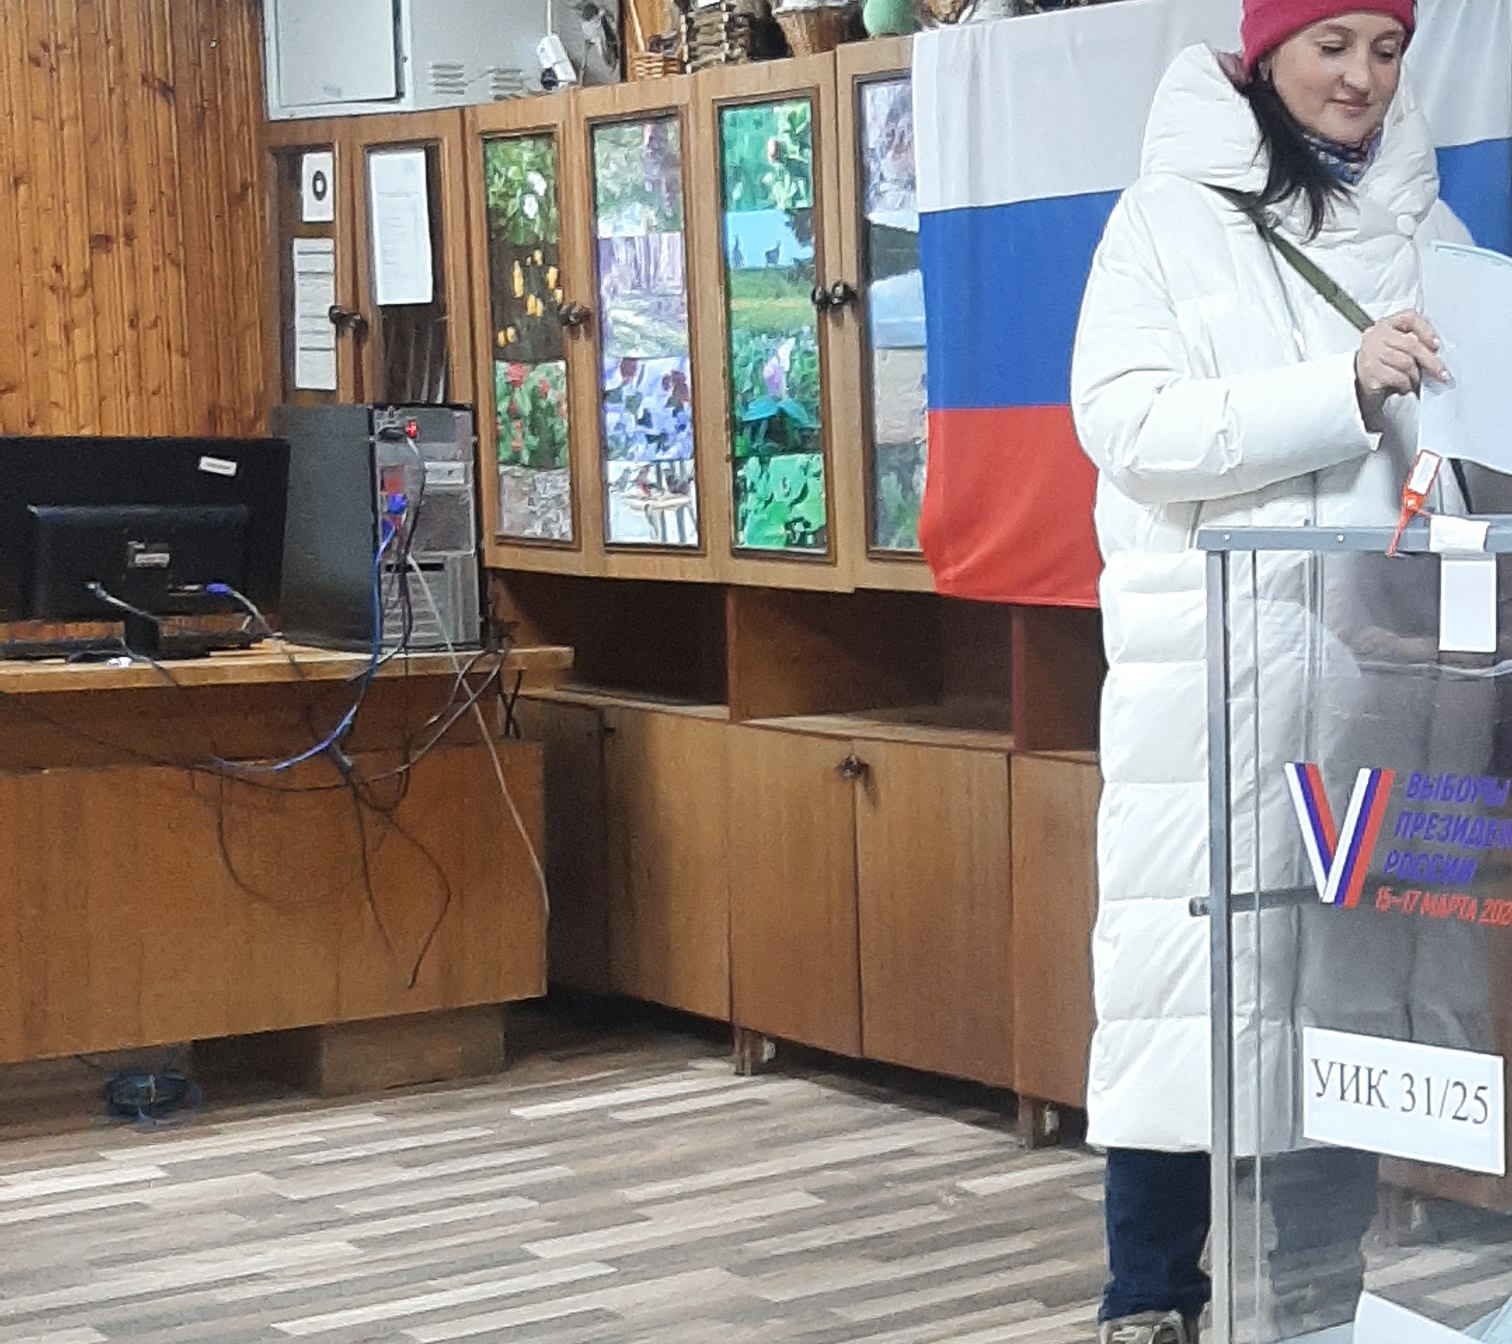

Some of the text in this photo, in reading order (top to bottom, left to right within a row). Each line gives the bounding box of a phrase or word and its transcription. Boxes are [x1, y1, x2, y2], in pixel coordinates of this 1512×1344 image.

[1406, 771, 1512, 808] ВЫБОРЫ
[1383, 849, 1478, 885] РОССИИ
[1421, 892, 1478, 923] МАРТА
[1310, 1058, 1489, 1125] УИК 31/25
